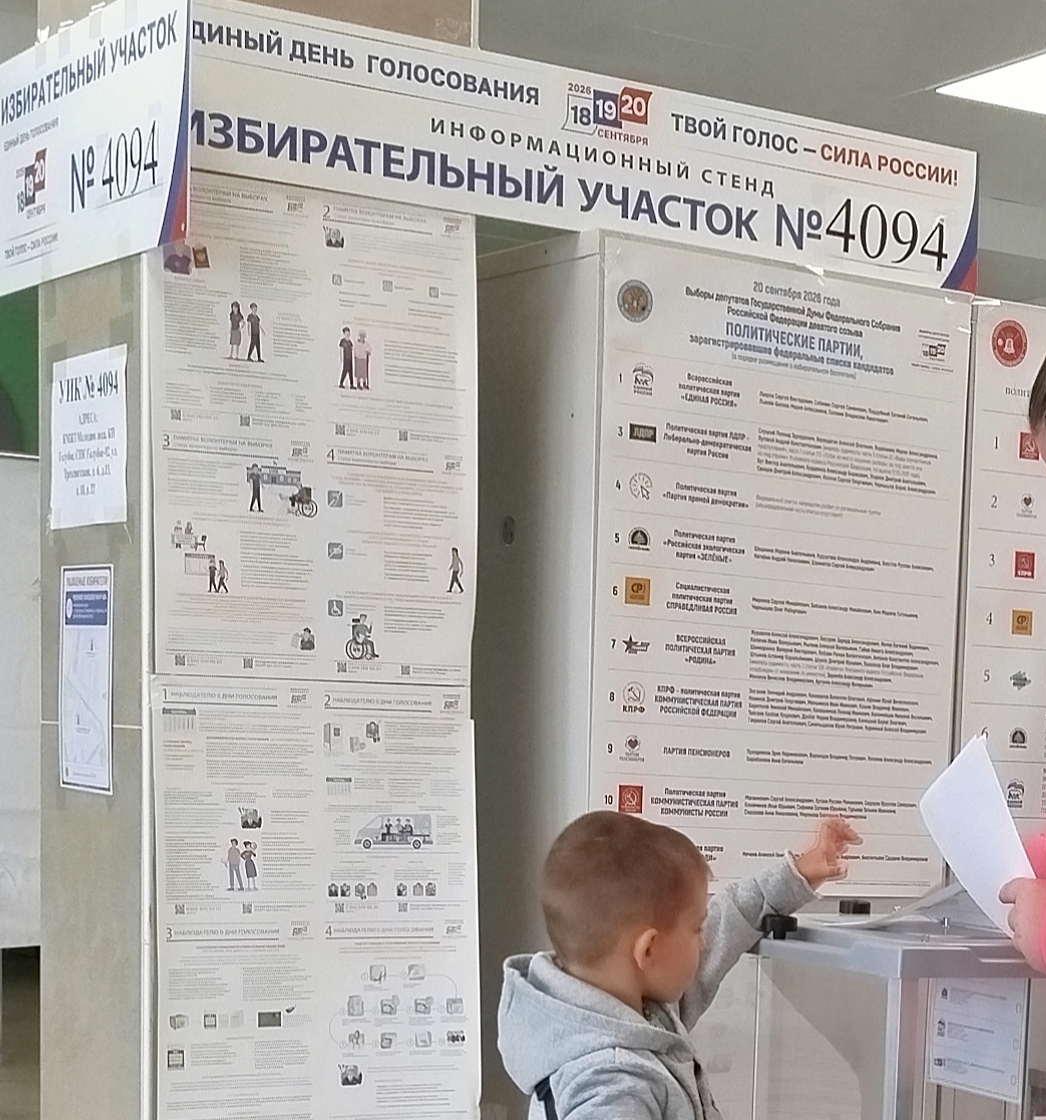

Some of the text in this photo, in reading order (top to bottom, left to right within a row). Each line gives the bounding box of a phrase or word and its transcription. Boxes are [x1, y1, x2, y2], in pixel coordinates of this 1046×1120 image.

[1, 10, 177, 126] ИЗБИРАТЕЛЬНЫЙ УЧАСТОК
[192, 20, 540, 106] ДИНЫЙ ДЕНЬ ГОЛОСОВАНИЯ
[566, 82, 592, 95] 2026
[571, 95, 646, 126] 18 19 20
[597, 128, 648, 146] СЕНТЯБРЯ
[671, 113, 727, 141] ТВОЙ
[732, 126, 798, 154] ГОЛОС
[821, 144, 872, 169] СИЛА
[878, 155, 958, 187] РОССИИ!
[430, 117, 774, 198] ИНФОРМАЦИОННЫЙ СТЕНД
[71, 120, 158, 213] № 4094
[323, 205, 330, 219] 2
[577, 178, 757, 241] УЧАСТОК
[753, 281, 763, 292] 20
[765, 284, 801, 300] сентября
[823, 295, 841, 307] года
[685, 286, 901, 333] Выборы депутатов Государственной Думы Федерального Собрания
[727, 305, 863, 338] Российской Федерации девятого созыва
[726, 322, 864, 361] ПОЛИТИЧЕСКИЕ ПАРТИИ,
[773, 347, 825, 364] федеральные
[826, 357, 851, 369] списки
[853, 361, 894, 376] кандидатов
[619, 373, 623, 384] 1
[687, 373, 732, 387] Всероссийская
[59, 376, 82, 404] УИК
[97, 369, 118, 397] 4094
[678, 383, 741, 399] политическая партия
[617, 426, 623, 437] 3
[666, 422, 746, 441] Политическая партия ЛДПР
[163, 434, 170, 447] 3
[663, 432, 752, 452] Либерально-демократическая
[994, 436, 998, 449] 1
[327, 448, 334, 461] 4
[687, 447, 729, 459] партия России
[615, 480, 621, 490] 4
[675, 482, 737, 498] Политическая партия
[990, 495, 998, 508] 2
[614, 533, 620, 543] 5
[674, 529, 736, 544] Политическая партия
[676, 551, 697, 561] партия
[989, 553, 996, 567] 3
[612, 586, 618, 596] 6
[675, 582, 730, 594] Социалистическая
[671, 592, 733, 605] политическая партия
[666, 601, 737, 615] СПРАВЕДЛИВАЯ РОССИЯ
[986, 612, 993, 625] 4
[611, 639, 616, 649] 7
[676, 634, 726, 645] ВСЕРОССИЙСКАЯ
[665, 643, 736, 657] ПОЛИТИЧЕСКАЯ ПАРТИЯ
[984, 669, 990, 683] 5
[163, 688, 167, 700] 1
[609, 692, 615, 702] 8
[657, 685, 741, 698] КПРФ политическая партия
[324, 694, 330, 708] 2
[654, 695, 742, 709] КОММУНИСТИЧЕСКАЯ ПАРТИЯ
[622, 705, 645, 713] КПРФ
[660, 705, 737, 718] РОССИЙСКОЙ ФЕДЕРАЦИИ
[607, 743, 613, 754] 9
[663, 746, 730, 758] ПАРТИЯ ПЕНСИОНЕРОВ
[604, 795, 613, 805] 10
[664, 788, 726, 799] Политическая партия
[650, 797, 715, 808] КОММУНИСТИЧЕСКАЯ
[715, 799, 738, 809] ПАРТИЯ
[660, 808, 728, 818] КОММУНИСТЫ РОССИИ
[166, 927, 172, 939] 3
[325, 925, 332, 937] 4
